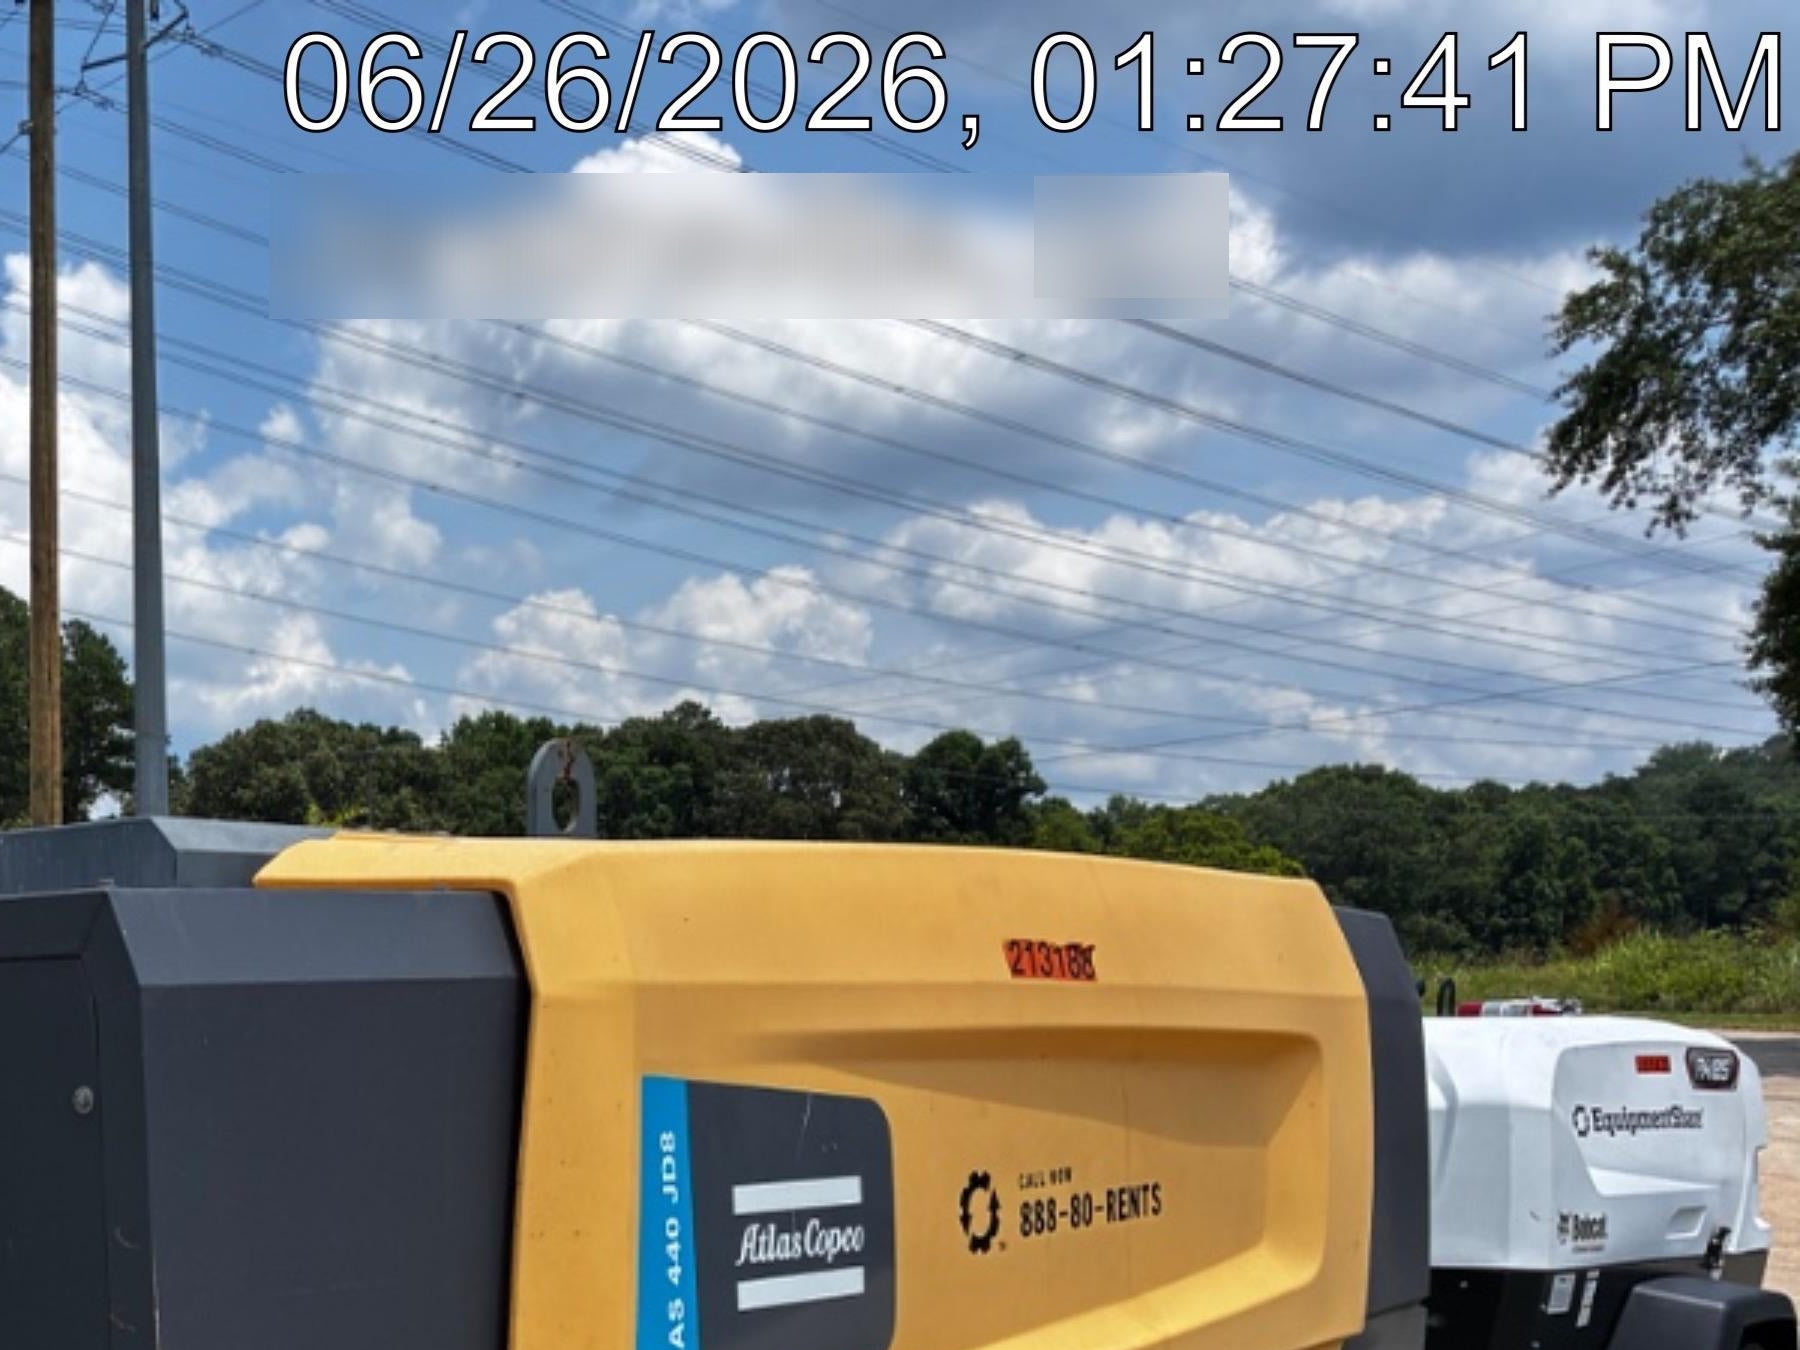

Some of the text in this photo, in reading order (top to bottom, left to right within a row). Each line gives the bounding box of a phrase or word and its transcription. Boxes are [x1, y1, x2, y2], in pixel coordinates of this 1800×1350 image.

[1006, 939, 1096, 979] 213188
[658, 1129, 680, 1205] JD8
[1018, 1172, 1046, 1190] CALL
[1019, 1181, 1162, 1238] 888-80-RENTS
[664, 1216, 682, 1287] 440
[734, 1217, 865, 1267] Atlas Copco
